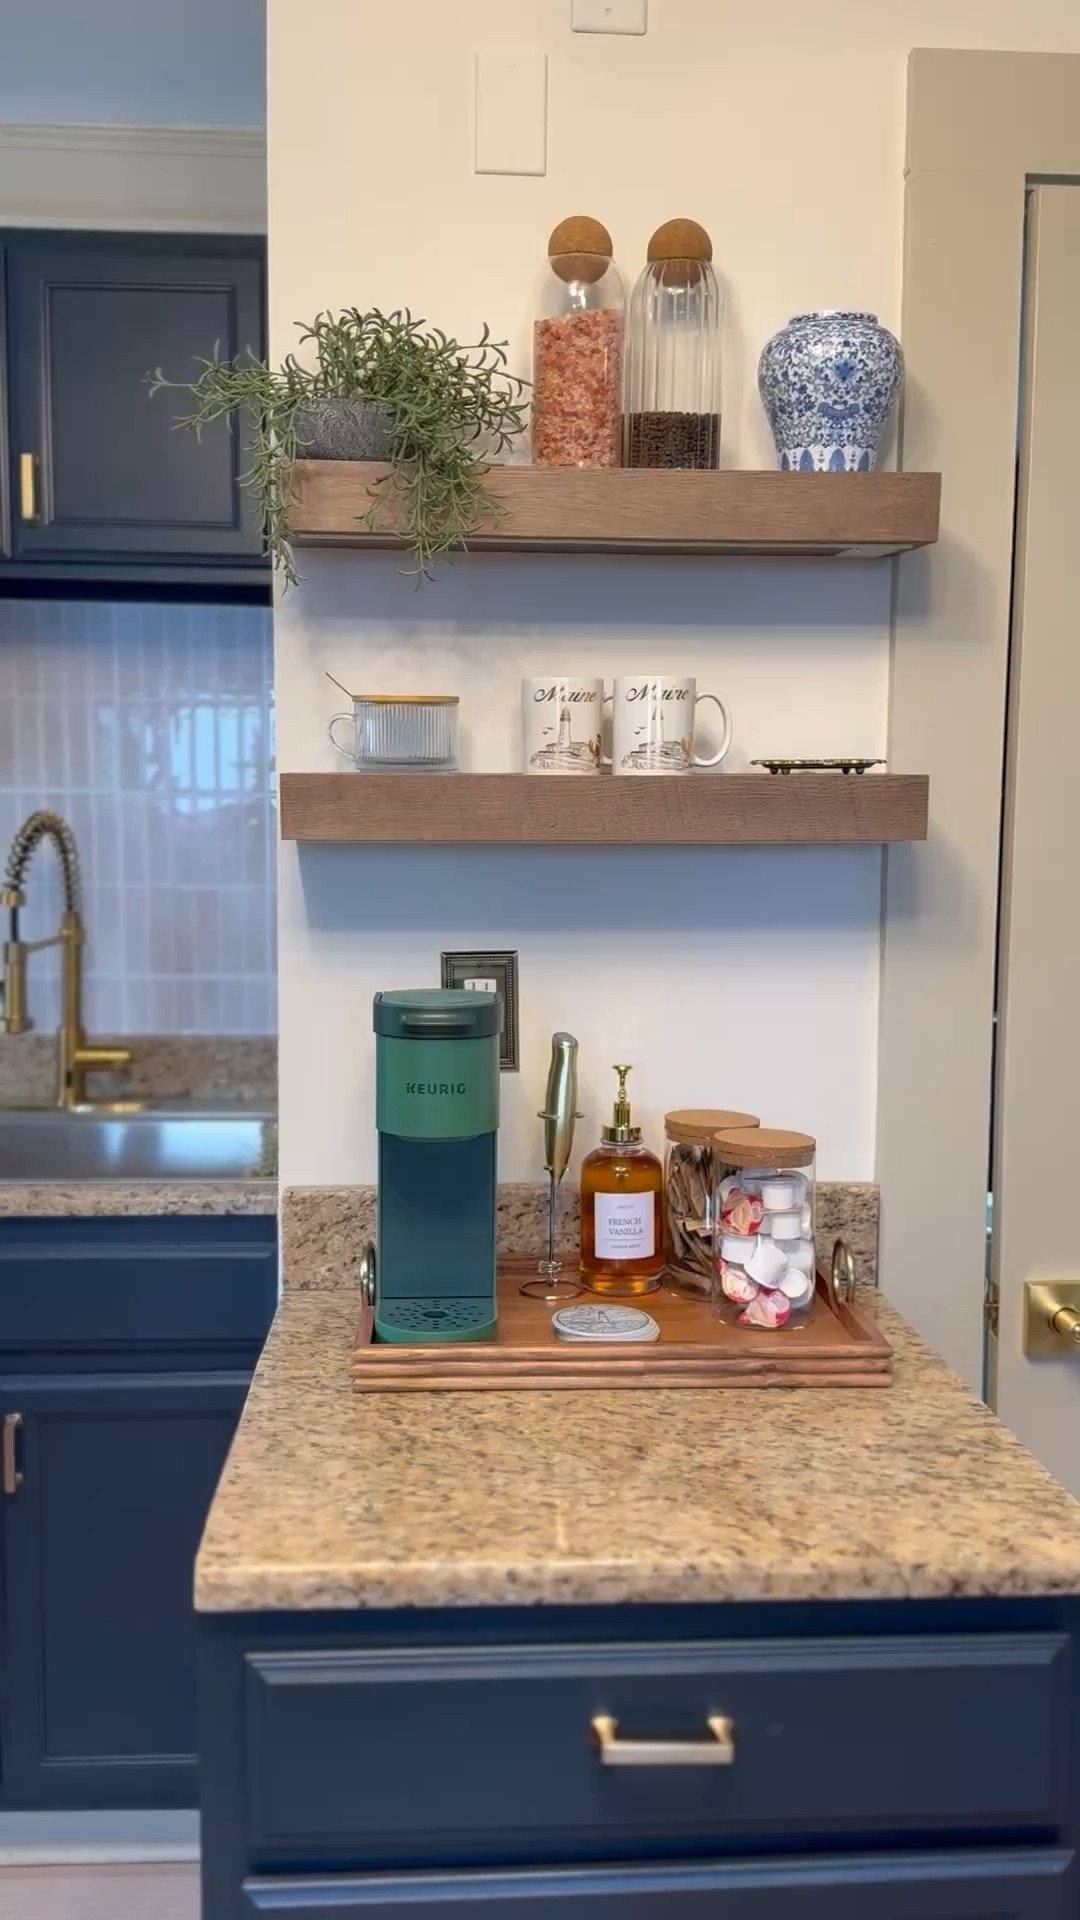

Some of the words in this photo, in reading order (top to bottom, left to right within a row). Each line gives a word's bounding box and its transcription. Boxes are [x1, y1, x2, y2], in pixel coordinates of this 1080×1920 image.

[406, 1082, 466, 1094] KEURIG
[608, 1217, 642, 1226] FRENCH
[608, 1228, 644, 1236] VANILLA
